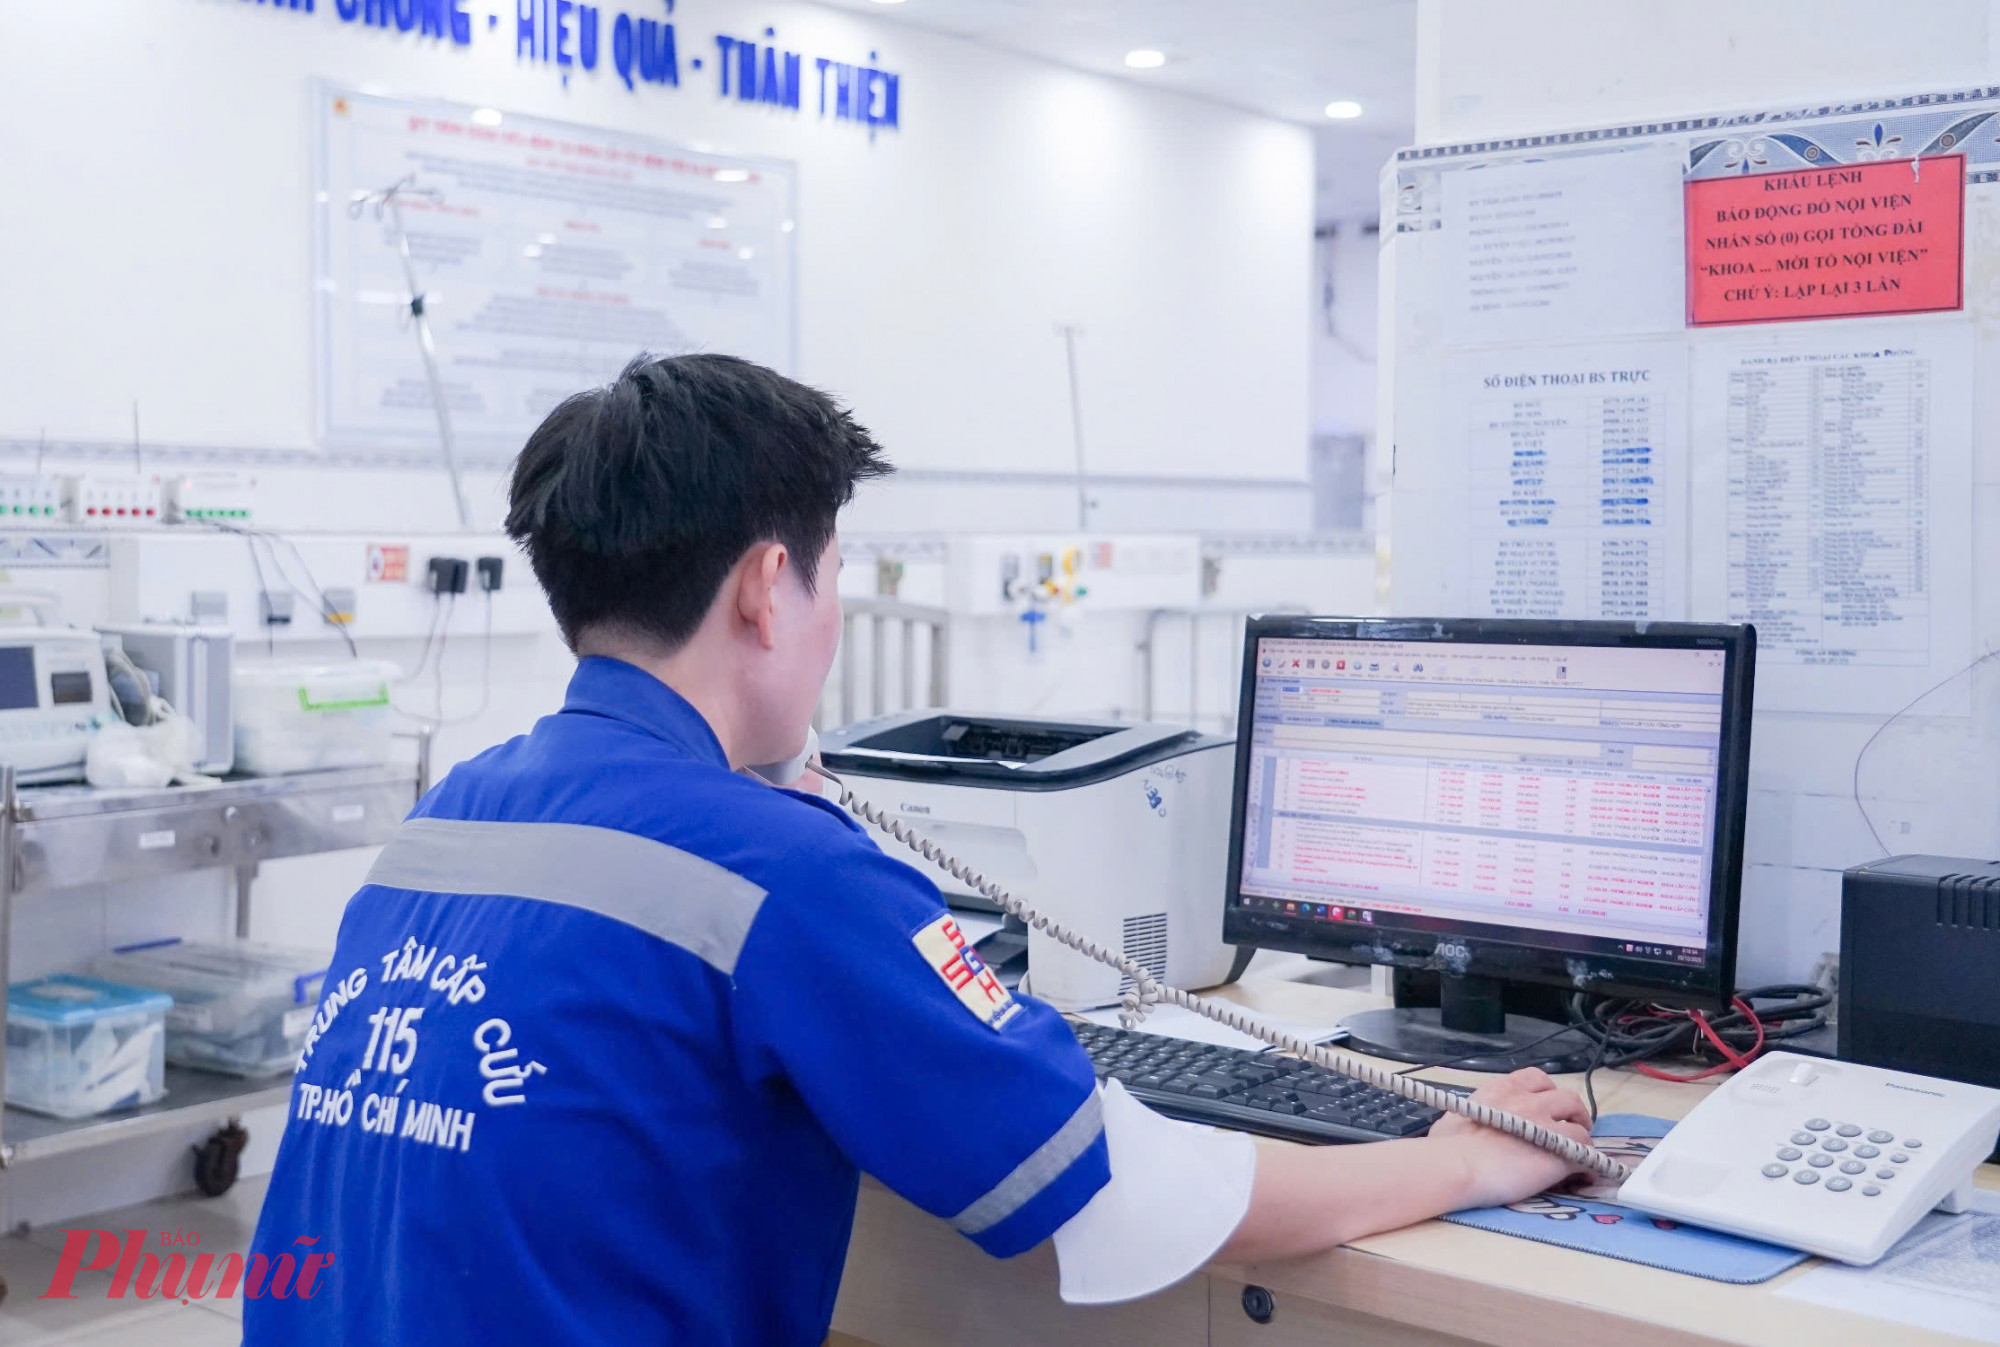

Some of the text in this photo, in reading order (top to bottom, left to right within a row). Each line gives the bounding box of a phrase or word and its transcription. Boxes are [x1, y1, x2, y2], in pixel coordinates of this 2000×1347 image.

[1816, 170, 1862, 188] LỆNH
[1716, 206, 1751, 223] BÁO
[1754, 203, 1801, 220] ĐỘNG
[1835, 196, 1866, 212] NỘI
[1871, 193, 1912, 210] VIỆN
[1803, 228, 1835, 245] GỌI
[1842, 251, 1873, 268] NỘI
[1820, 280, 1849, 298] LẠI
[1853, 280, 1862, 293] 3
[1504, 372, 1537, 389] ĐIỆN
[1541, 372, 1586, 387] THOẠI
[1589, 370, 1607, 384] BS
[1610, 369, 1651, 385] TRỰC
[1434, 942, 1466, 958] AOC
[381, 935, 437, 983] TÂM
[473, 1017, 548, 1106] CỨU
[361, 1006, 426, 1075] 115
[360, 1078, 410, 1135] CHÍ
[401, 1098, 476, 1152] MINH
